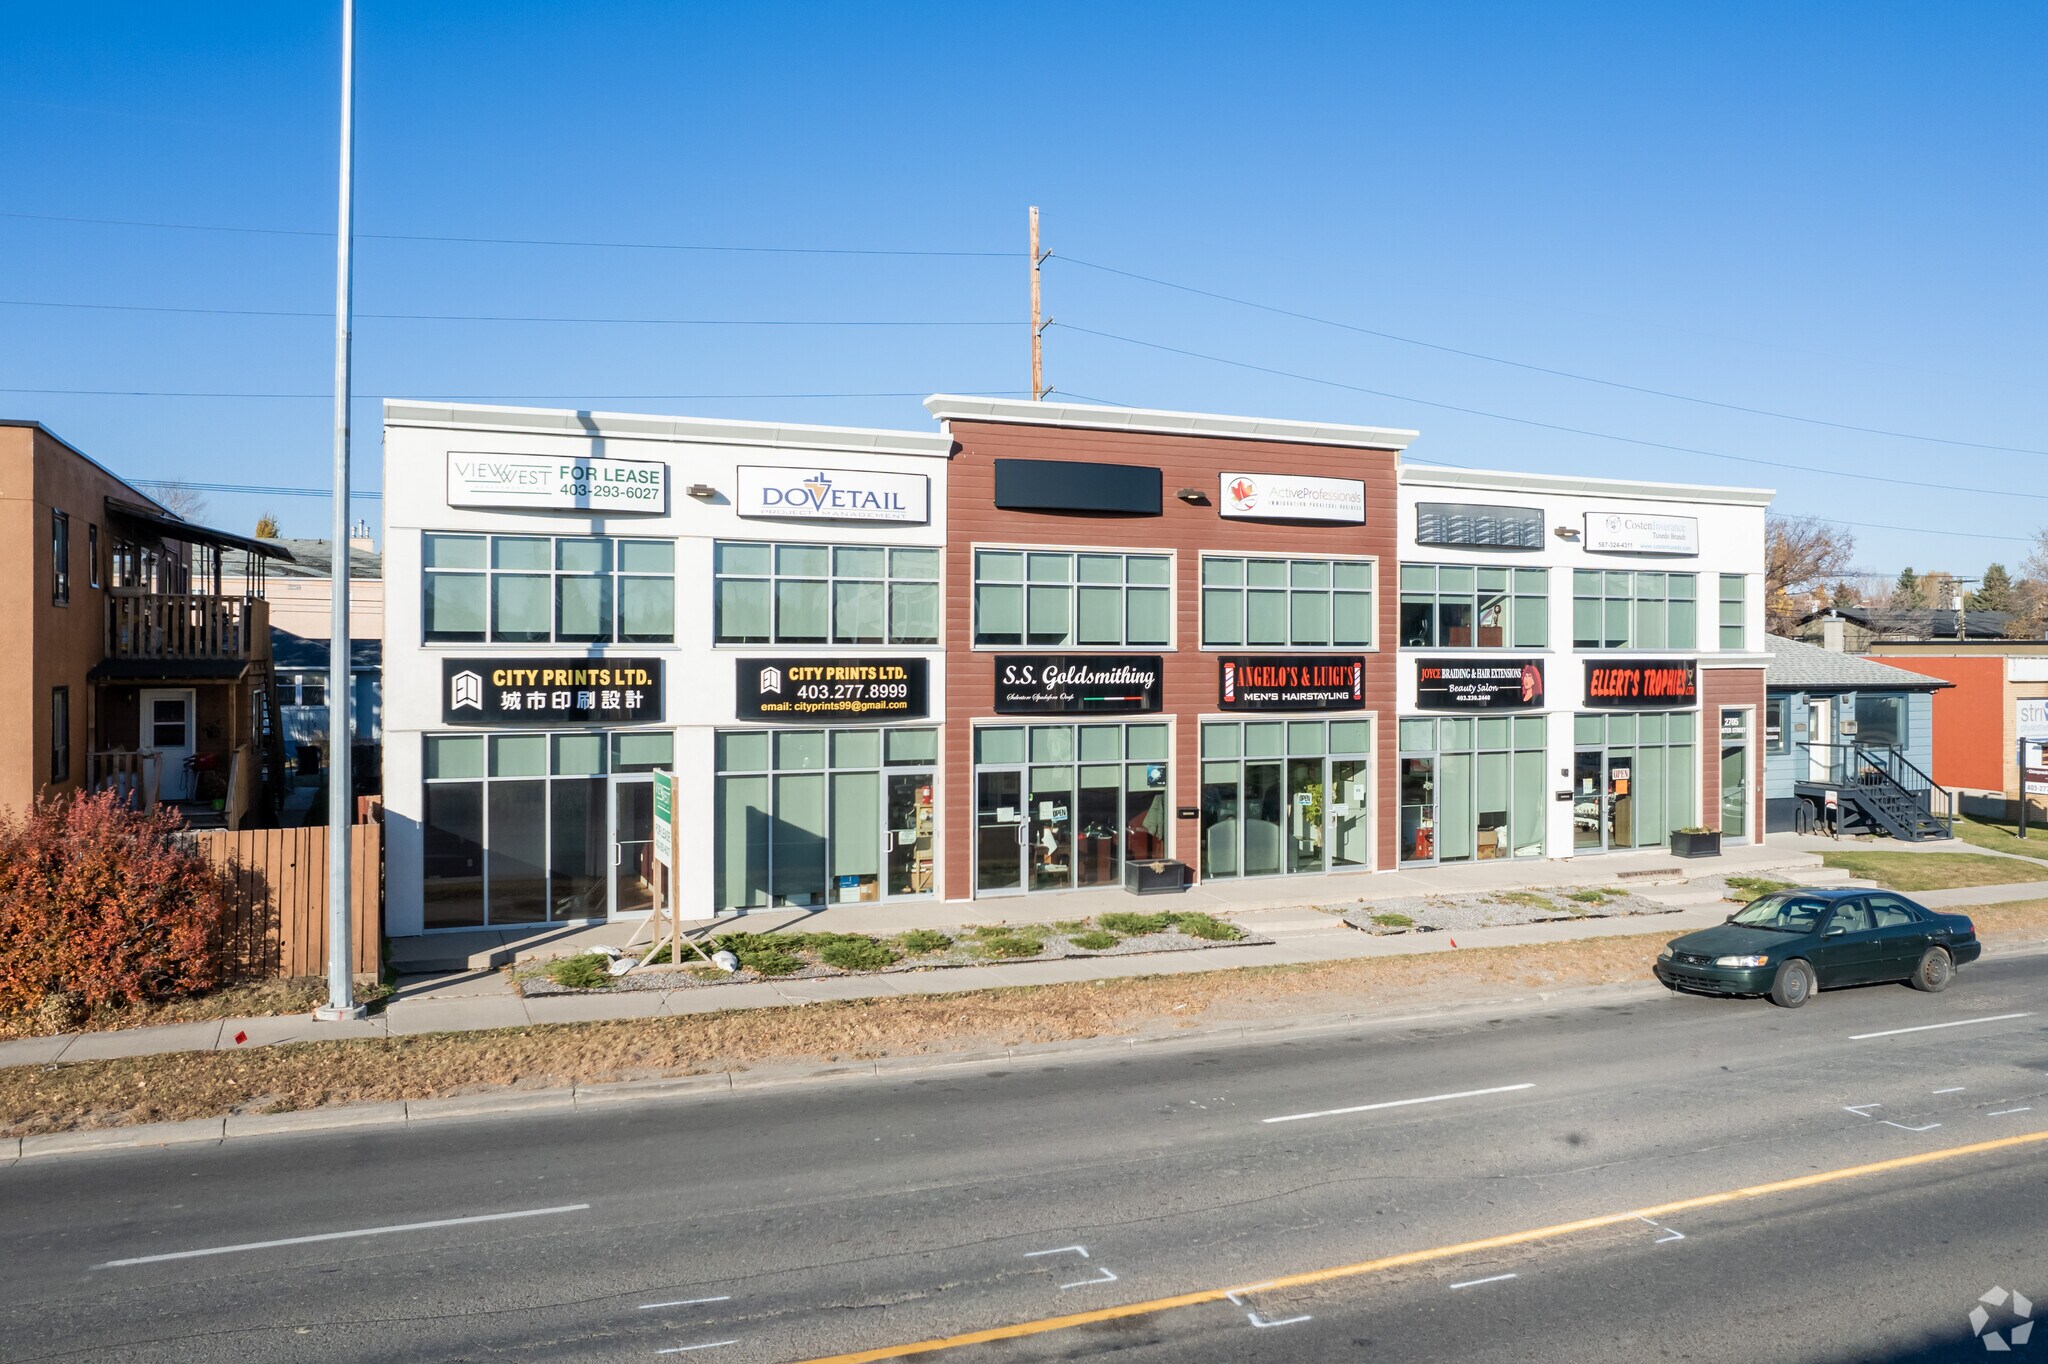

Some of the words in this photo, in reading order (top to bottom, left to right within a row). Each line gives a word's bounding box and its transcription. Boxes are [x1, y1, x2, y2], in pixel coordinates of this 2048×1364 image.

[560, 466, 596, 480] FOR
[605, 469, 659, 484] LEASE
[560, 484, 659, 499] 403-293-6027
[762, 483, 906, 512] DOVETAIL
[1269, 487, 1361, 503] ActiveProfessionals
[821, 511, 907, 519] MANAGEMENT
[492, 669, 539, 686] CITY
[543, 669, 611, 686] PRINTS
[615, 669, 652, 685] LTD.
[789, 667, 824, 681] CITY
[826, 667, 877, 680] PRINTS
[879, 666, 907, 680] LTD.
[1003, 665, 1037, 685] S.S.
[1042, 665, 1155, 690] Goldsmithing
[1237, 666, 1298, 687] ANGELO'S
[1301, 667, 1311, 686] &
[1314, 666, 1353, 686] LUIGI'S
[1421, 668, 1441, 682] JOYCE
[1441, 668, 1471, 679] BRAIDING
[1471, 668, 1477, 679] &
[1477, 668, 1490, 679] HAIR
[1491, 668, 1521, 679] EXTENSIONS
[1449, 684, 1477, 694] Beauty
[1477, 683, 1499, 692] Salon
[1590, 669, 1640, 696] ELLERT'S
[1644, 669, 1686, 696] TROPHIES
[797, 684, 907, 699] 403.277.8999
[1244, 693, 1278, 701] MEN'S
[1282, 692, 1349, 700] HAIRSTAYLING
[501, 690, 644, 710] 城市印刷設計
[761, 702, 792, 711] email:
[794, 701, 907, 713] cityprints99@gmail.com
[1613, 770, 1628, 778] OPEN
[1053, 808, 1066, 817] OPEN
